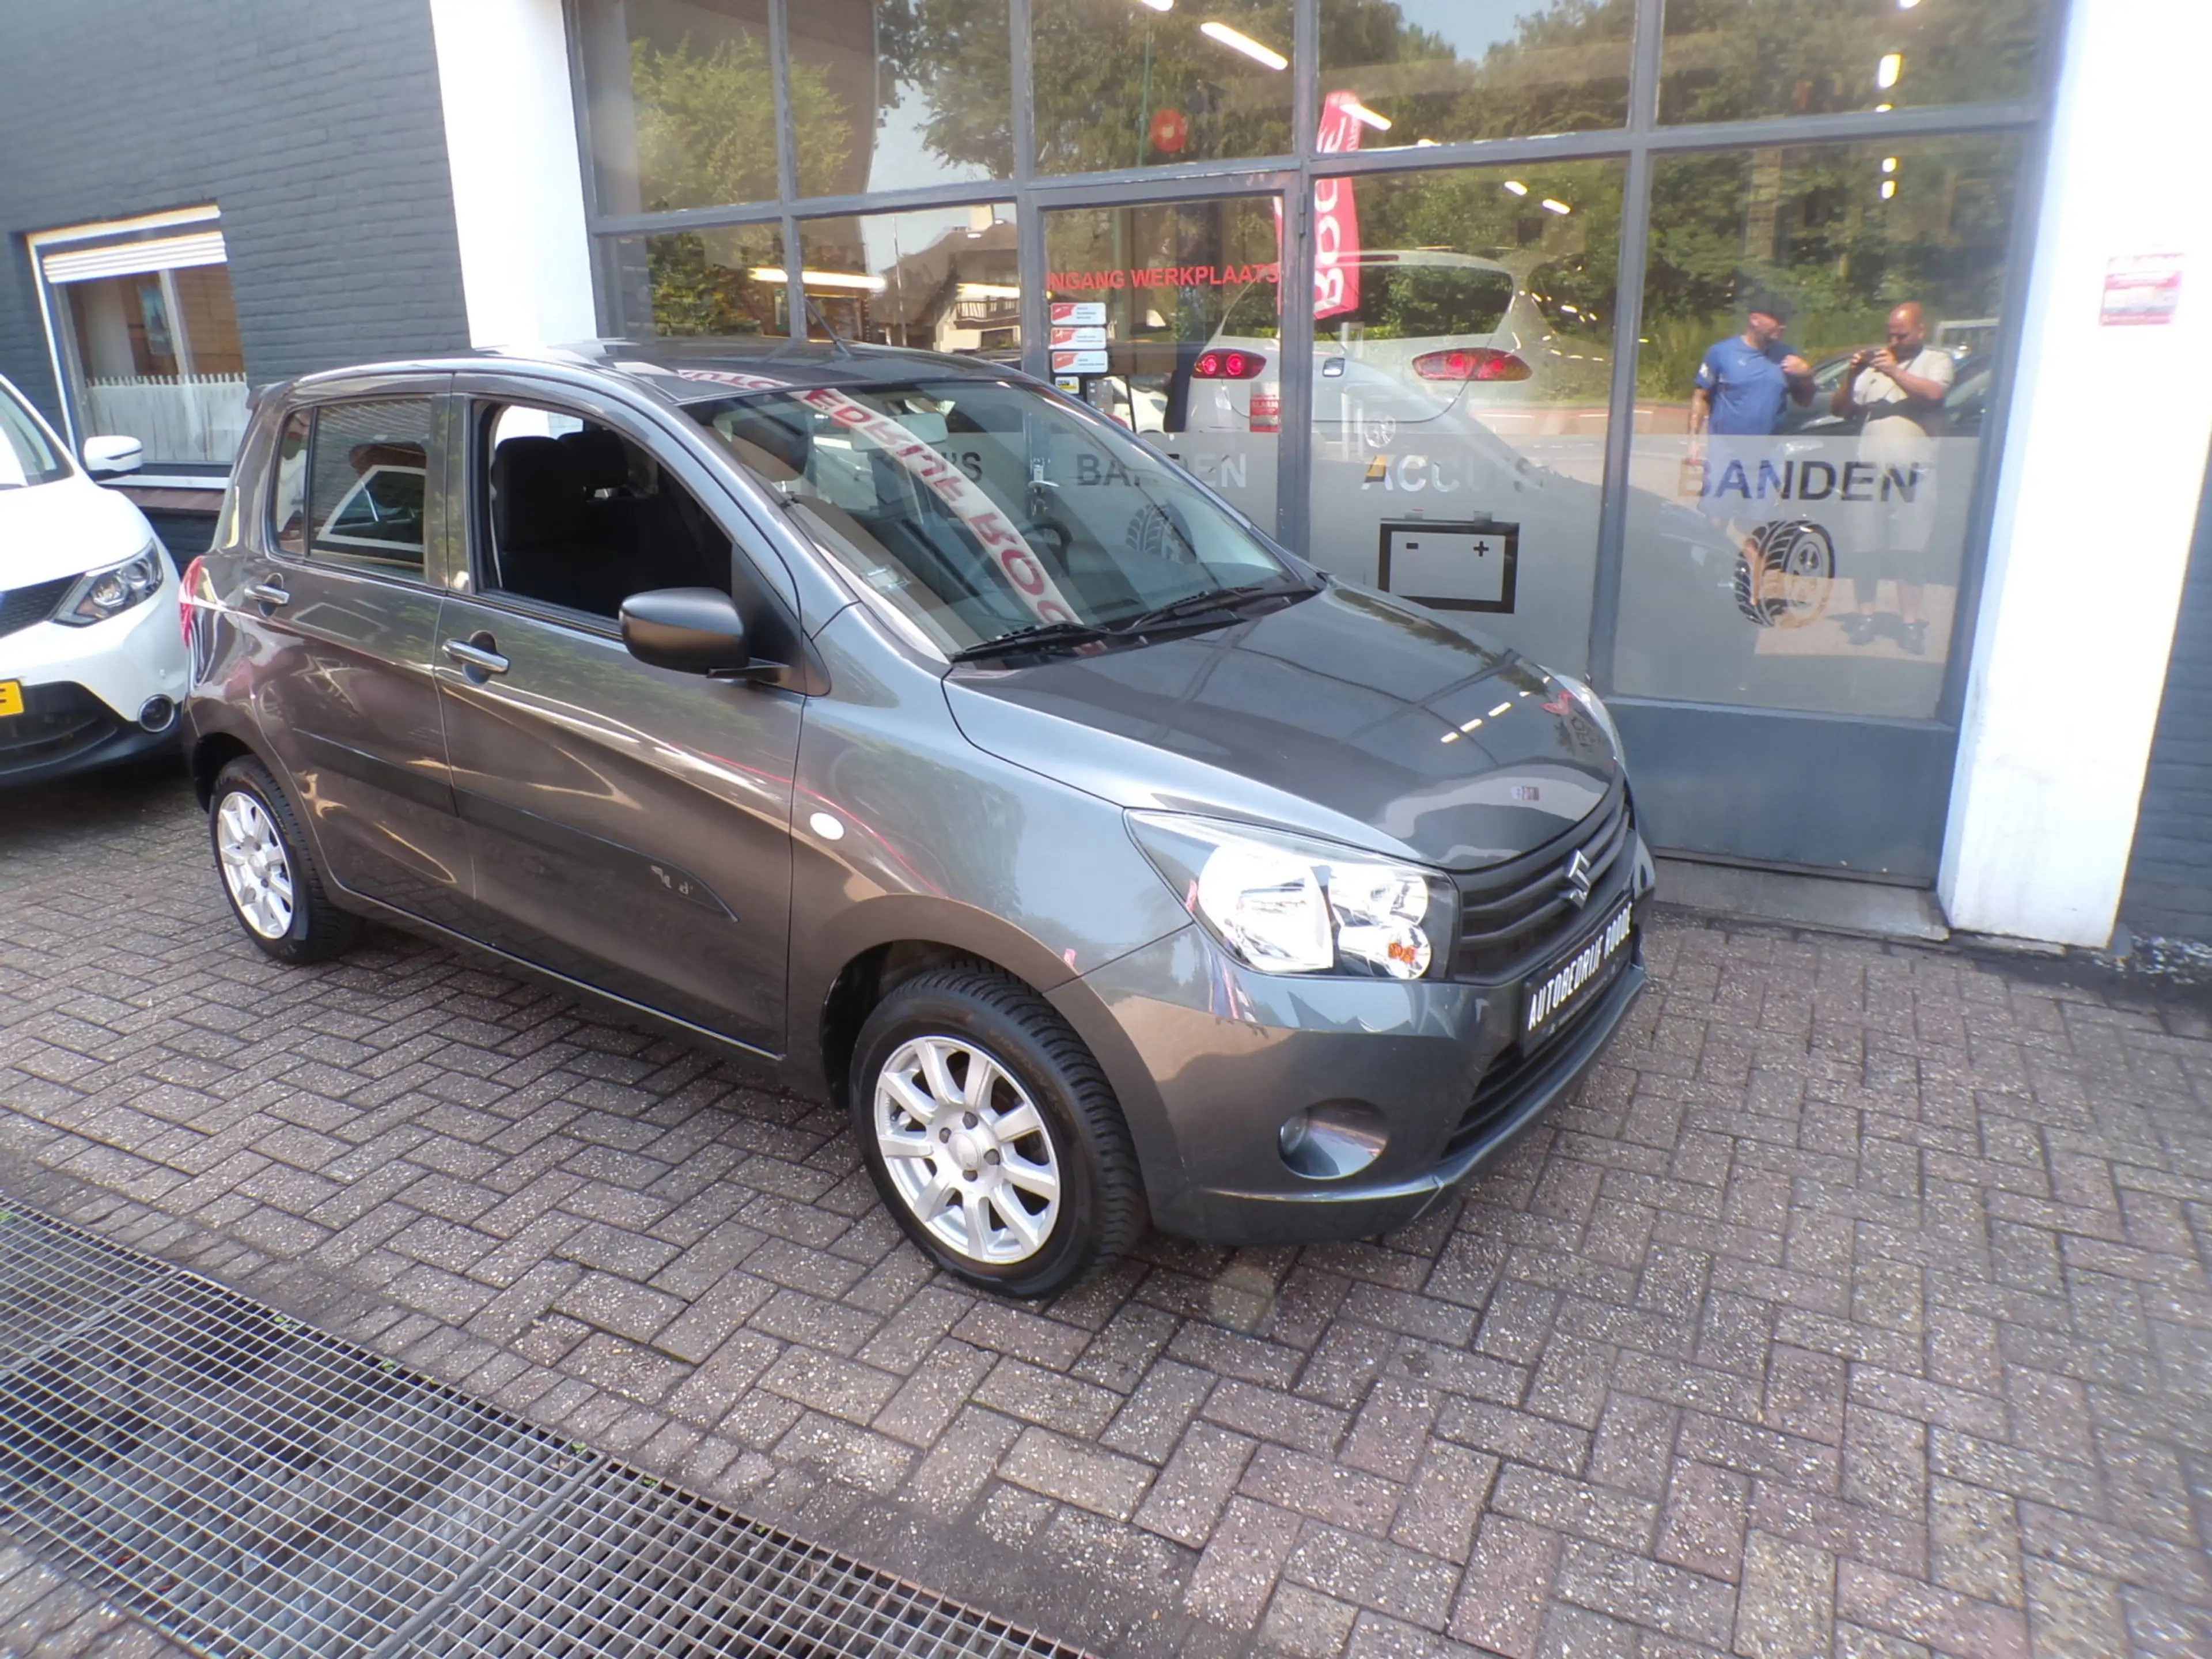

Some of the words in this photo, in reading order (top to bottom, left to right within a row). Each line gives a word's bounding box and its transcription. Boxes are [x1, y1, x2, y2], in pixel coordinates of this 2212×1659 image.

[1130, 263, 1280, 289] WERKPLAATS
[1677, 459, 1920, 503] BANDEN
[1528, 934, 1604, 1031] AUTOBEDRIJF
